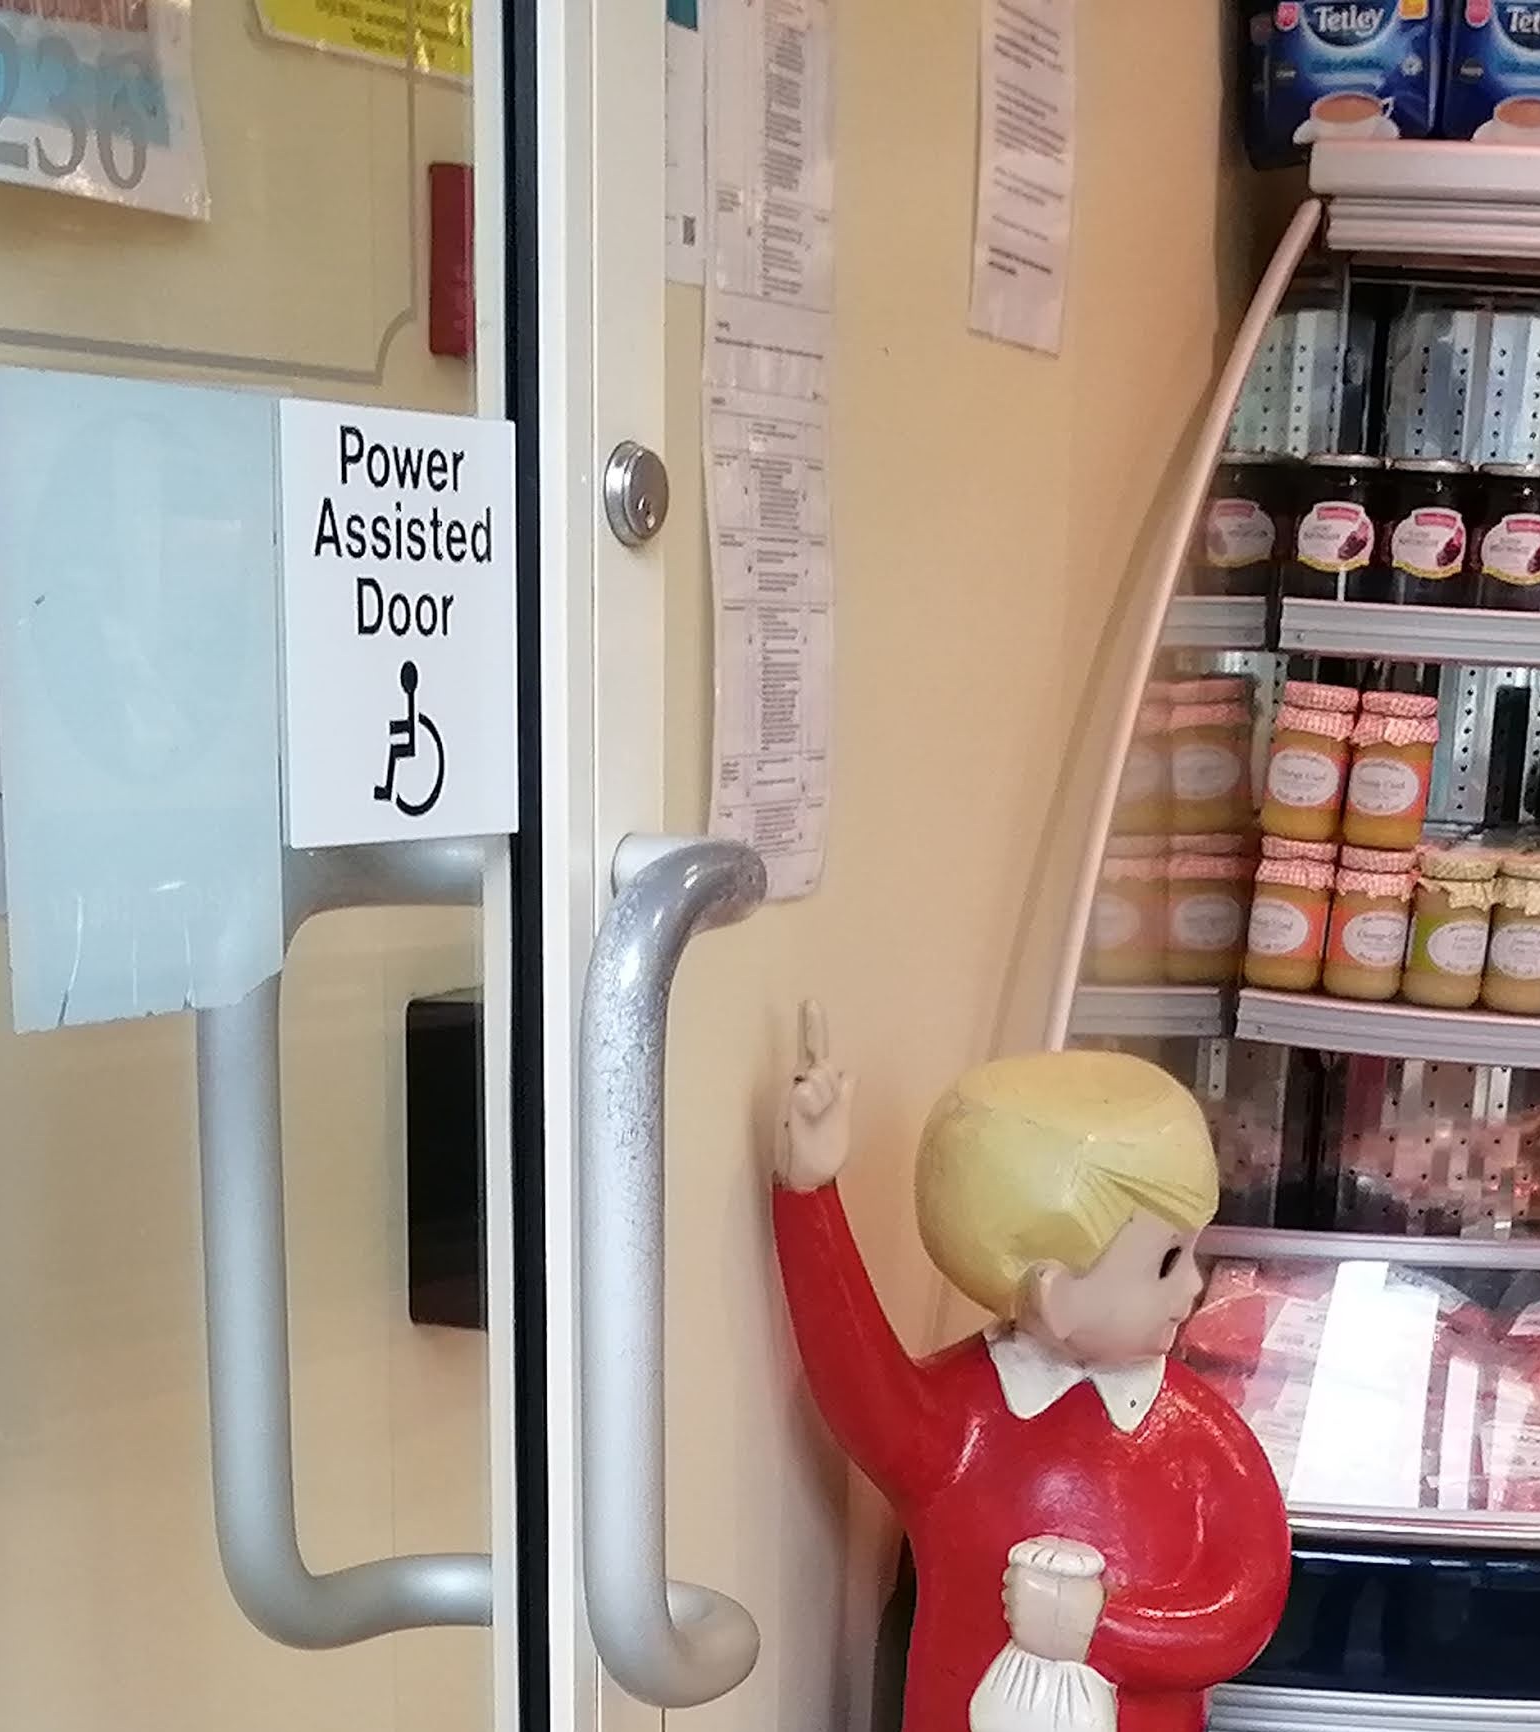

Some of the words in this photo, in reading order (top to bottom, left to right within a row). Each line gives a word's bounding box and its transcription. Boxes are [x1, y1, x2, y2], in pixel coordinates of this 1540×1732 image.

[1312, 4, 1385, 37] Tetley
[340, 424, 466, 492] Power
[314, 497, 493, 564] Assisted
[356, 577, 455, 639] Door
